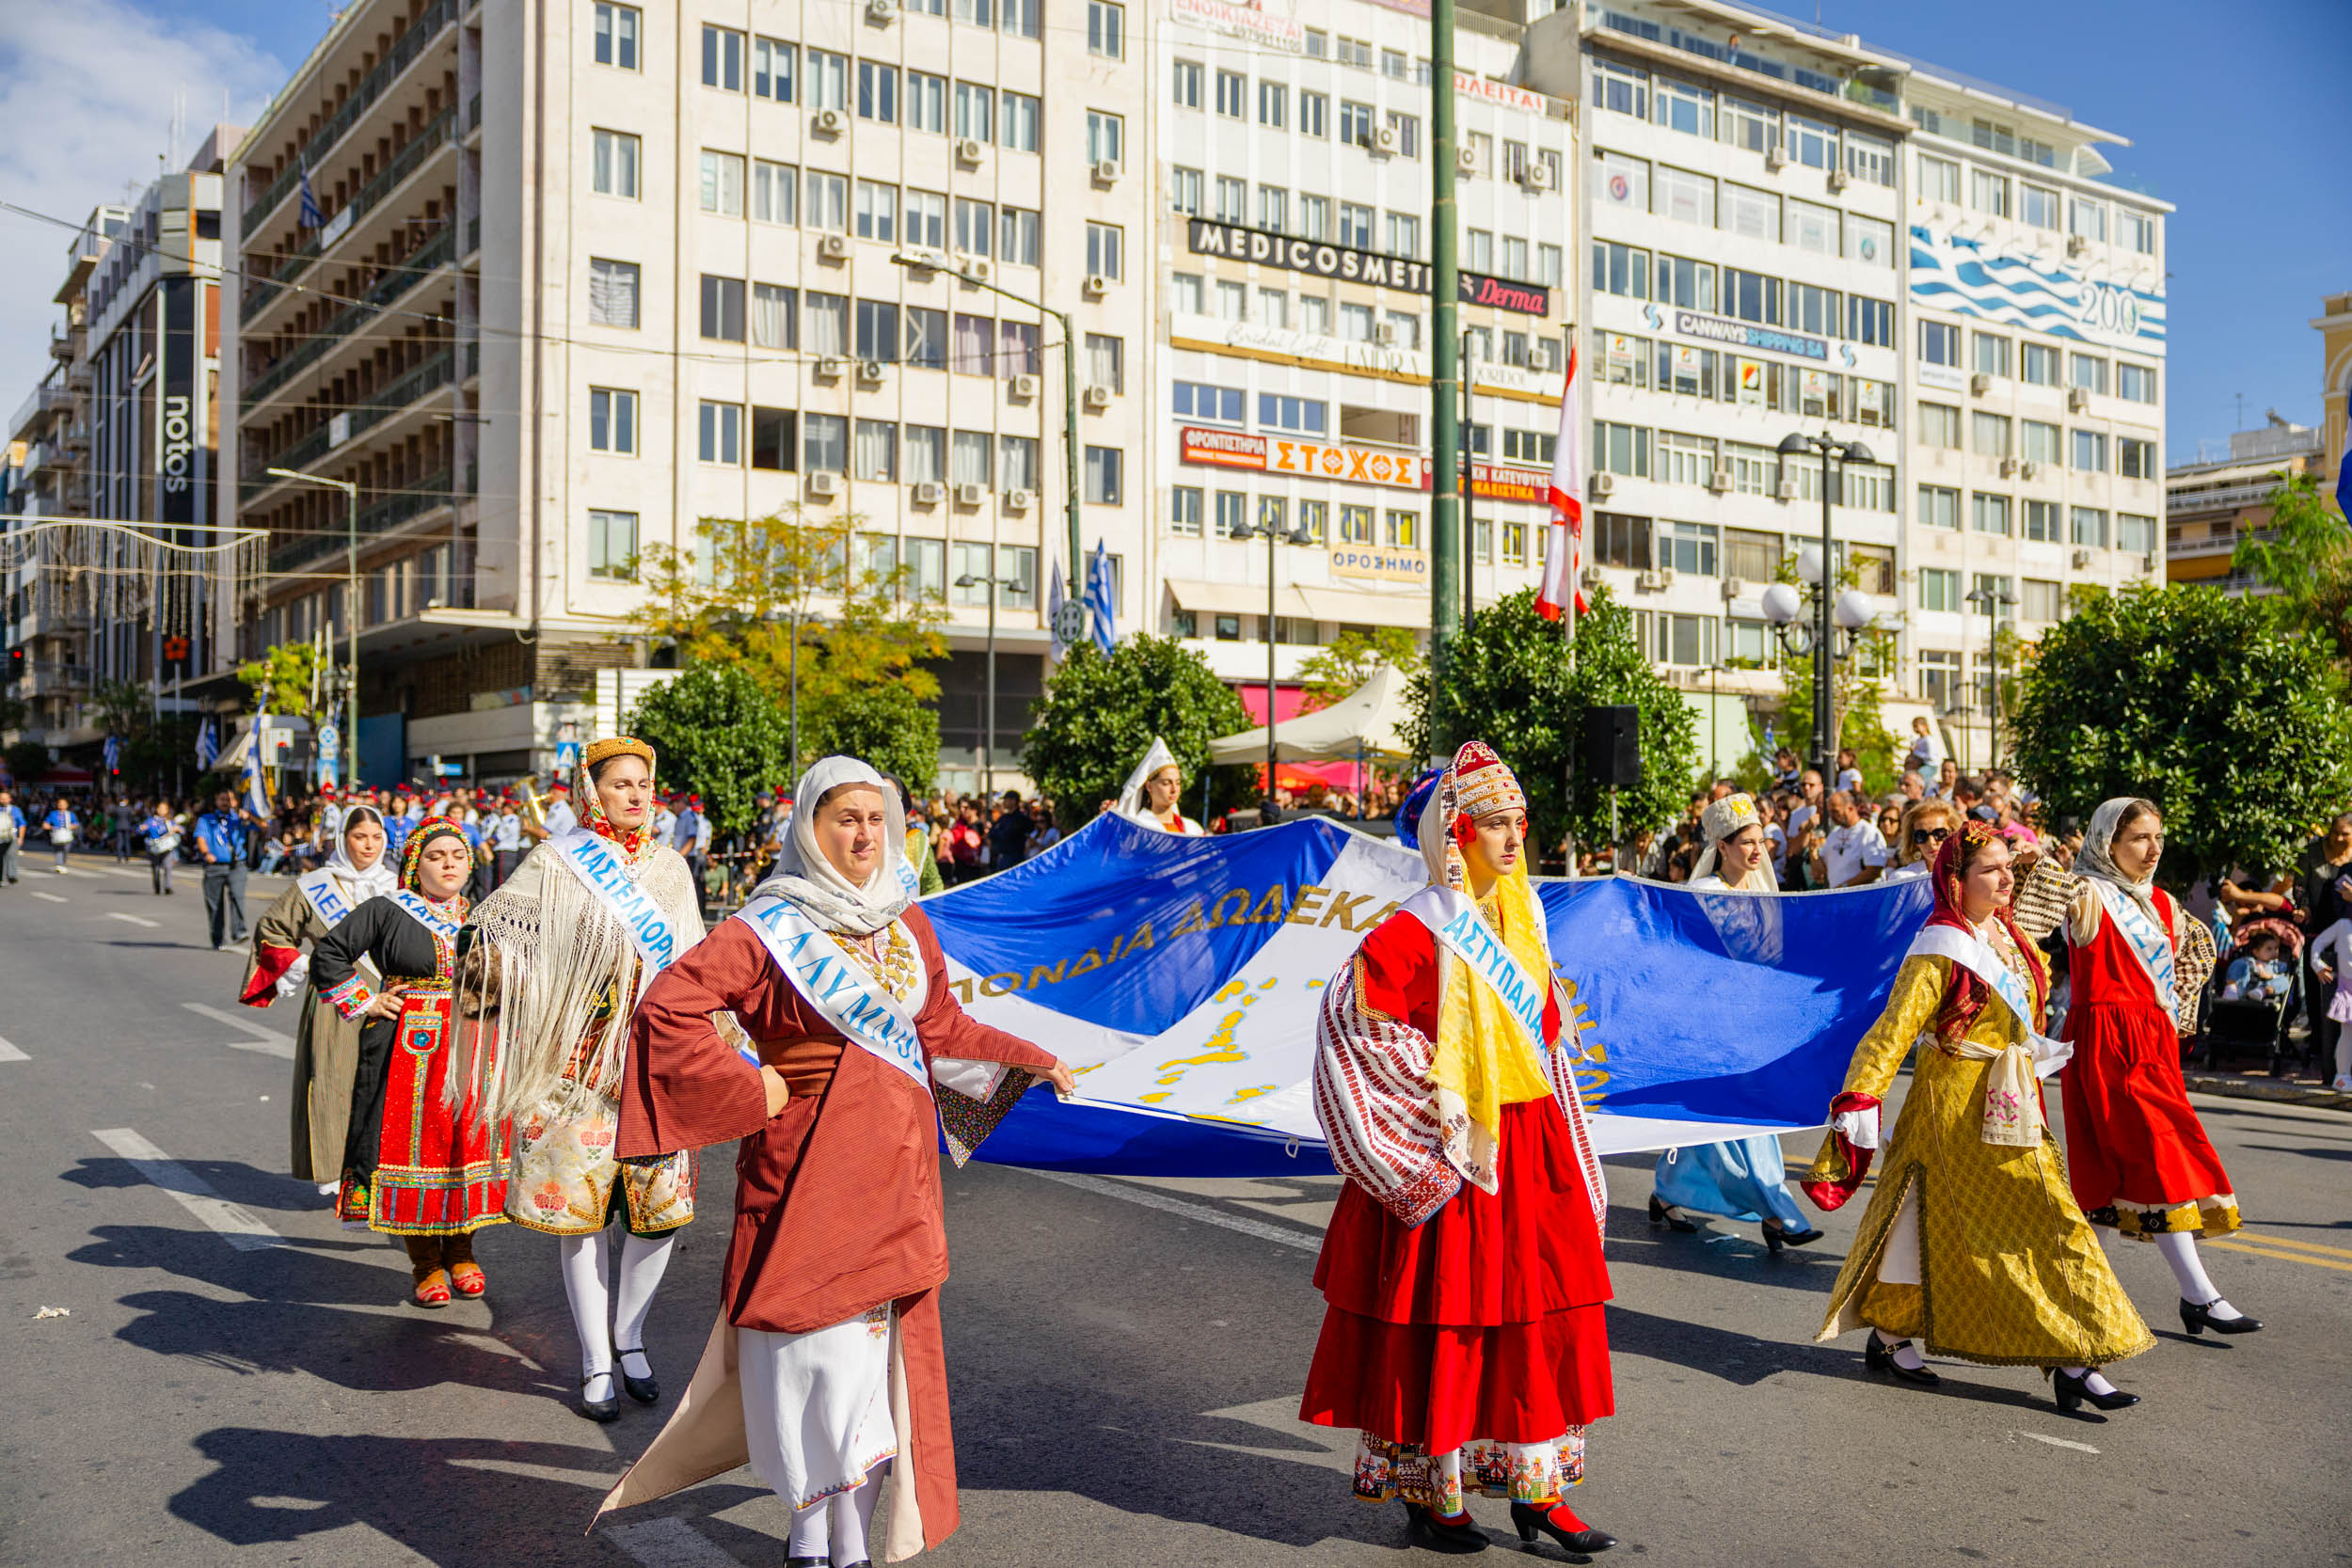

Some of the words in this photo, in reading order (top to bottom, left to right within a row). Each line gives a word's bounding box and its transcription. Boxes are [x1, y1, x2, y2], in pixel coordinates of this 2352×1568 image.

[1454, 74, 1542, 109] ΩΛΕΙΤΑΙ
[1198, 222, 1432, 293] MEDICOSMETI
[1476, 277, 1545, 313] Derma
[2080, 286, 2137, 335] 200
[166, 395, 193, 494] notos
[1277, 441, 1412, 484] ΣΤΟΧΟΣ
[1333, 551, 1425, 573] ΟΡΟΣΗΜΟ
[308, 882, 349, 921] ΛΕΡ
[571, 838, 674, 970] ΚΑΣΤΕΛΛΟΡΙ
[1169, 883, 1401, 939] ΔΩΔΕΚΑ
